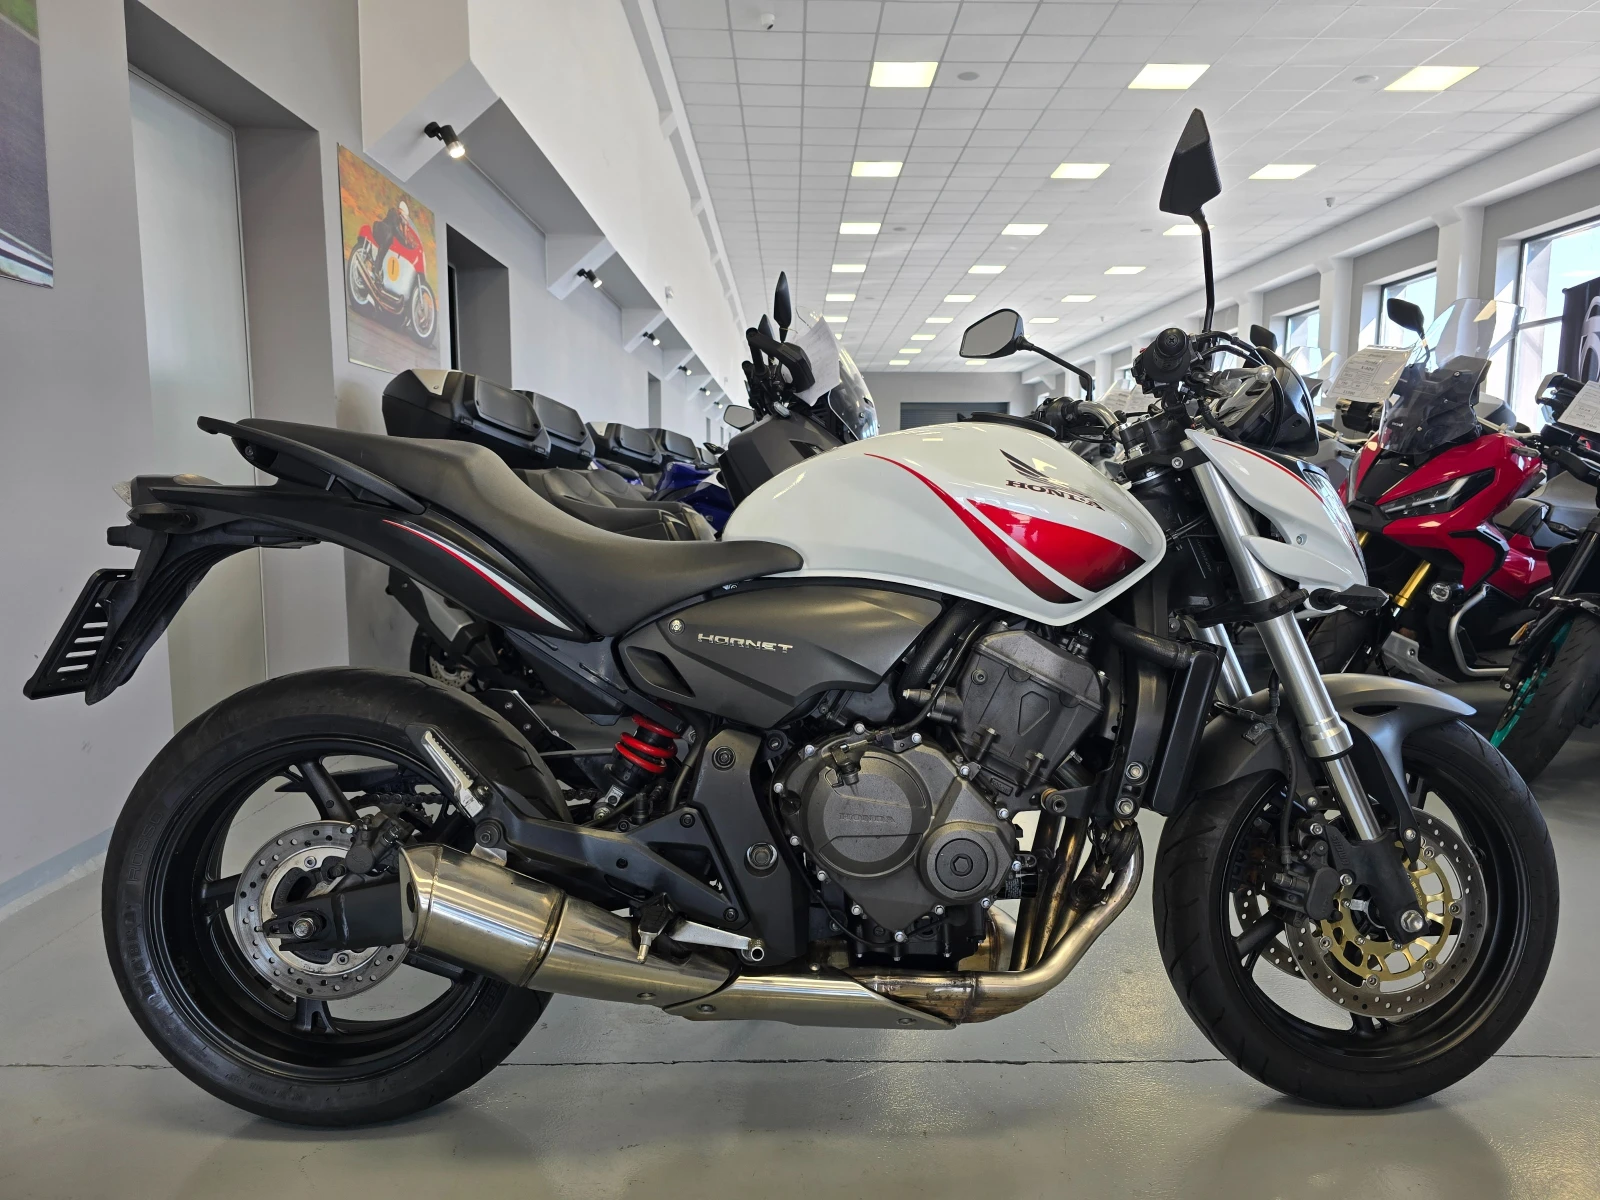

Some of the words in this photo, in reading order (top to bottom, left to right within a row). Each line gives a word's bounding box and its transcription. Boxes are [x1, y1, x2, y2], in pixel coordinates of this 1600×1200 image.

[697, 633, 794, 654] HORNET
[838, 812, 896, 823] HONDA
[128, 811, 163, 884] ROSSO
